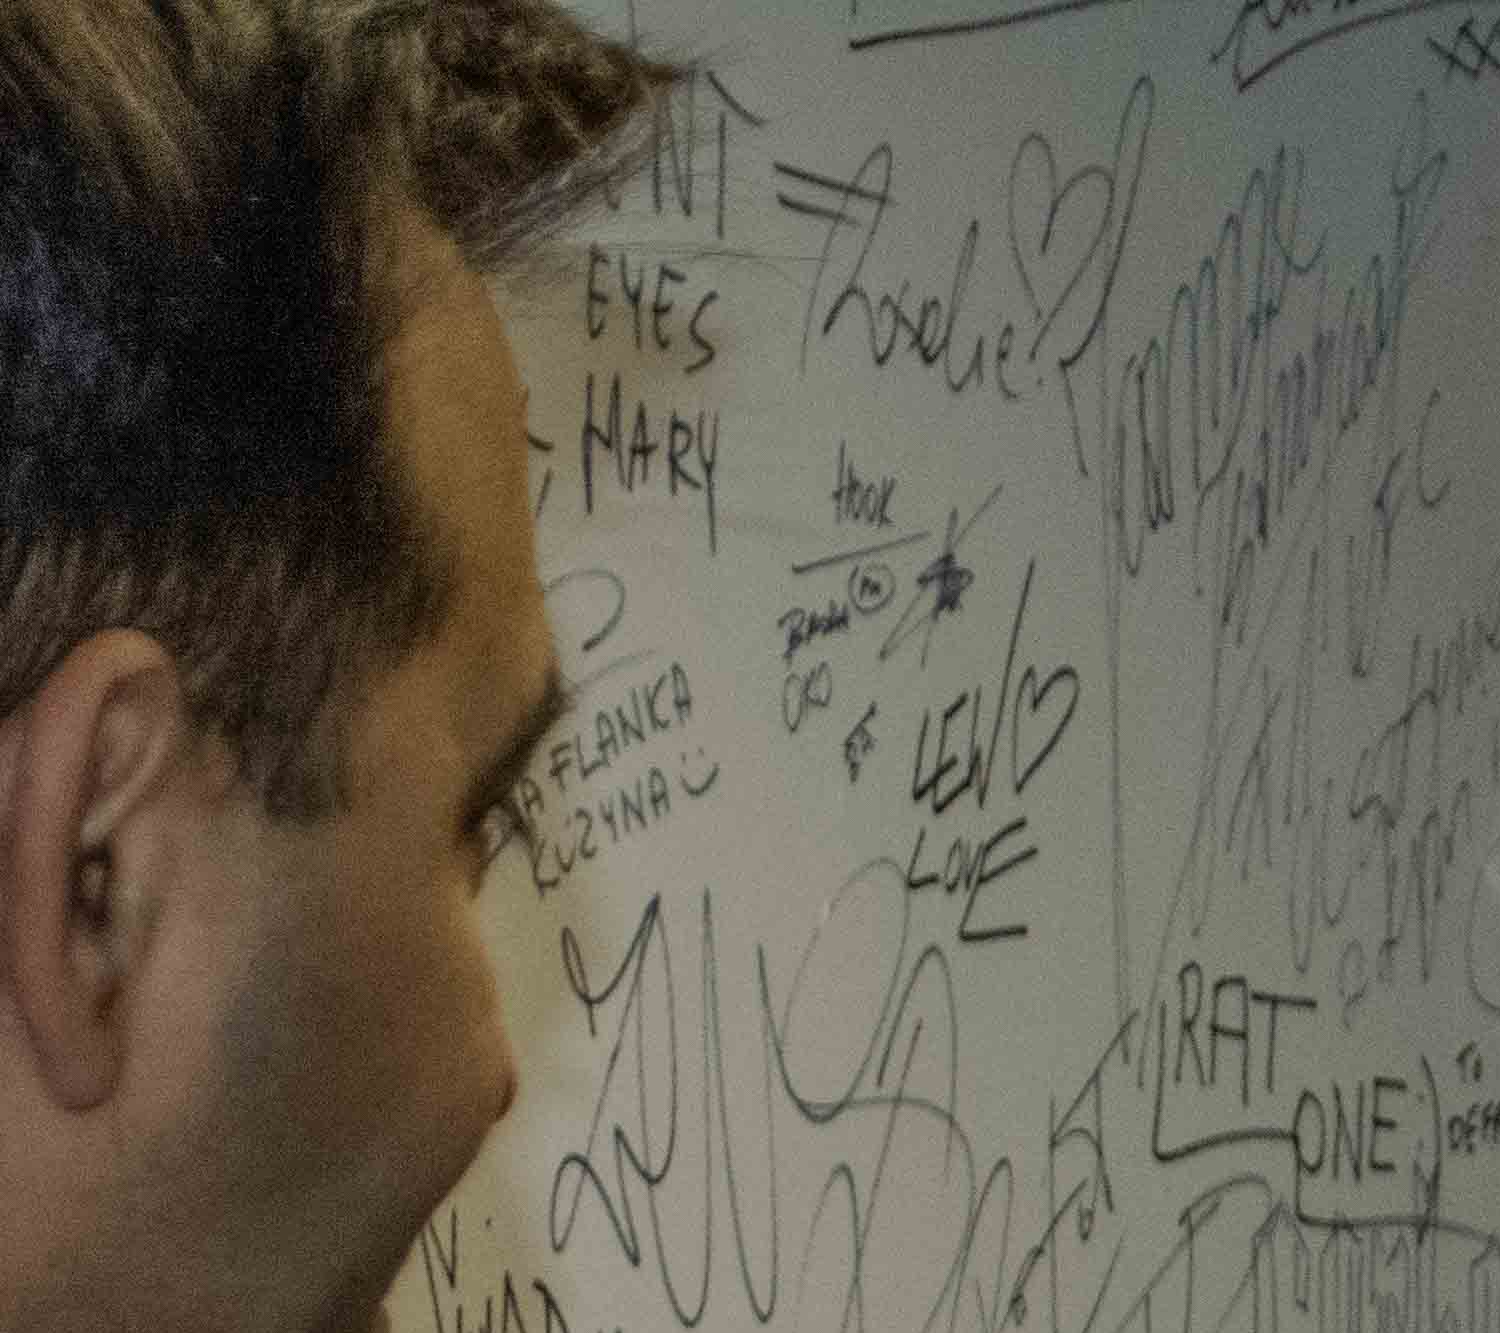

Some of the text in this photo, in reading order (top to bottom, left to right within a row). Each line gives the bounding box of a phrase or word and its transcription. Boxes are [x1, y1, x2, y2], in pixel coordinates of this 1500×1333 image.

[586, 244, 718, 376] EYES
[581, 372, 719, 555] MARY
[907, 816, 1038, 943] LOVE
[1174, 958, 1318, 1108] RAT
[1294, 1076, 1407, 1182] ONE
